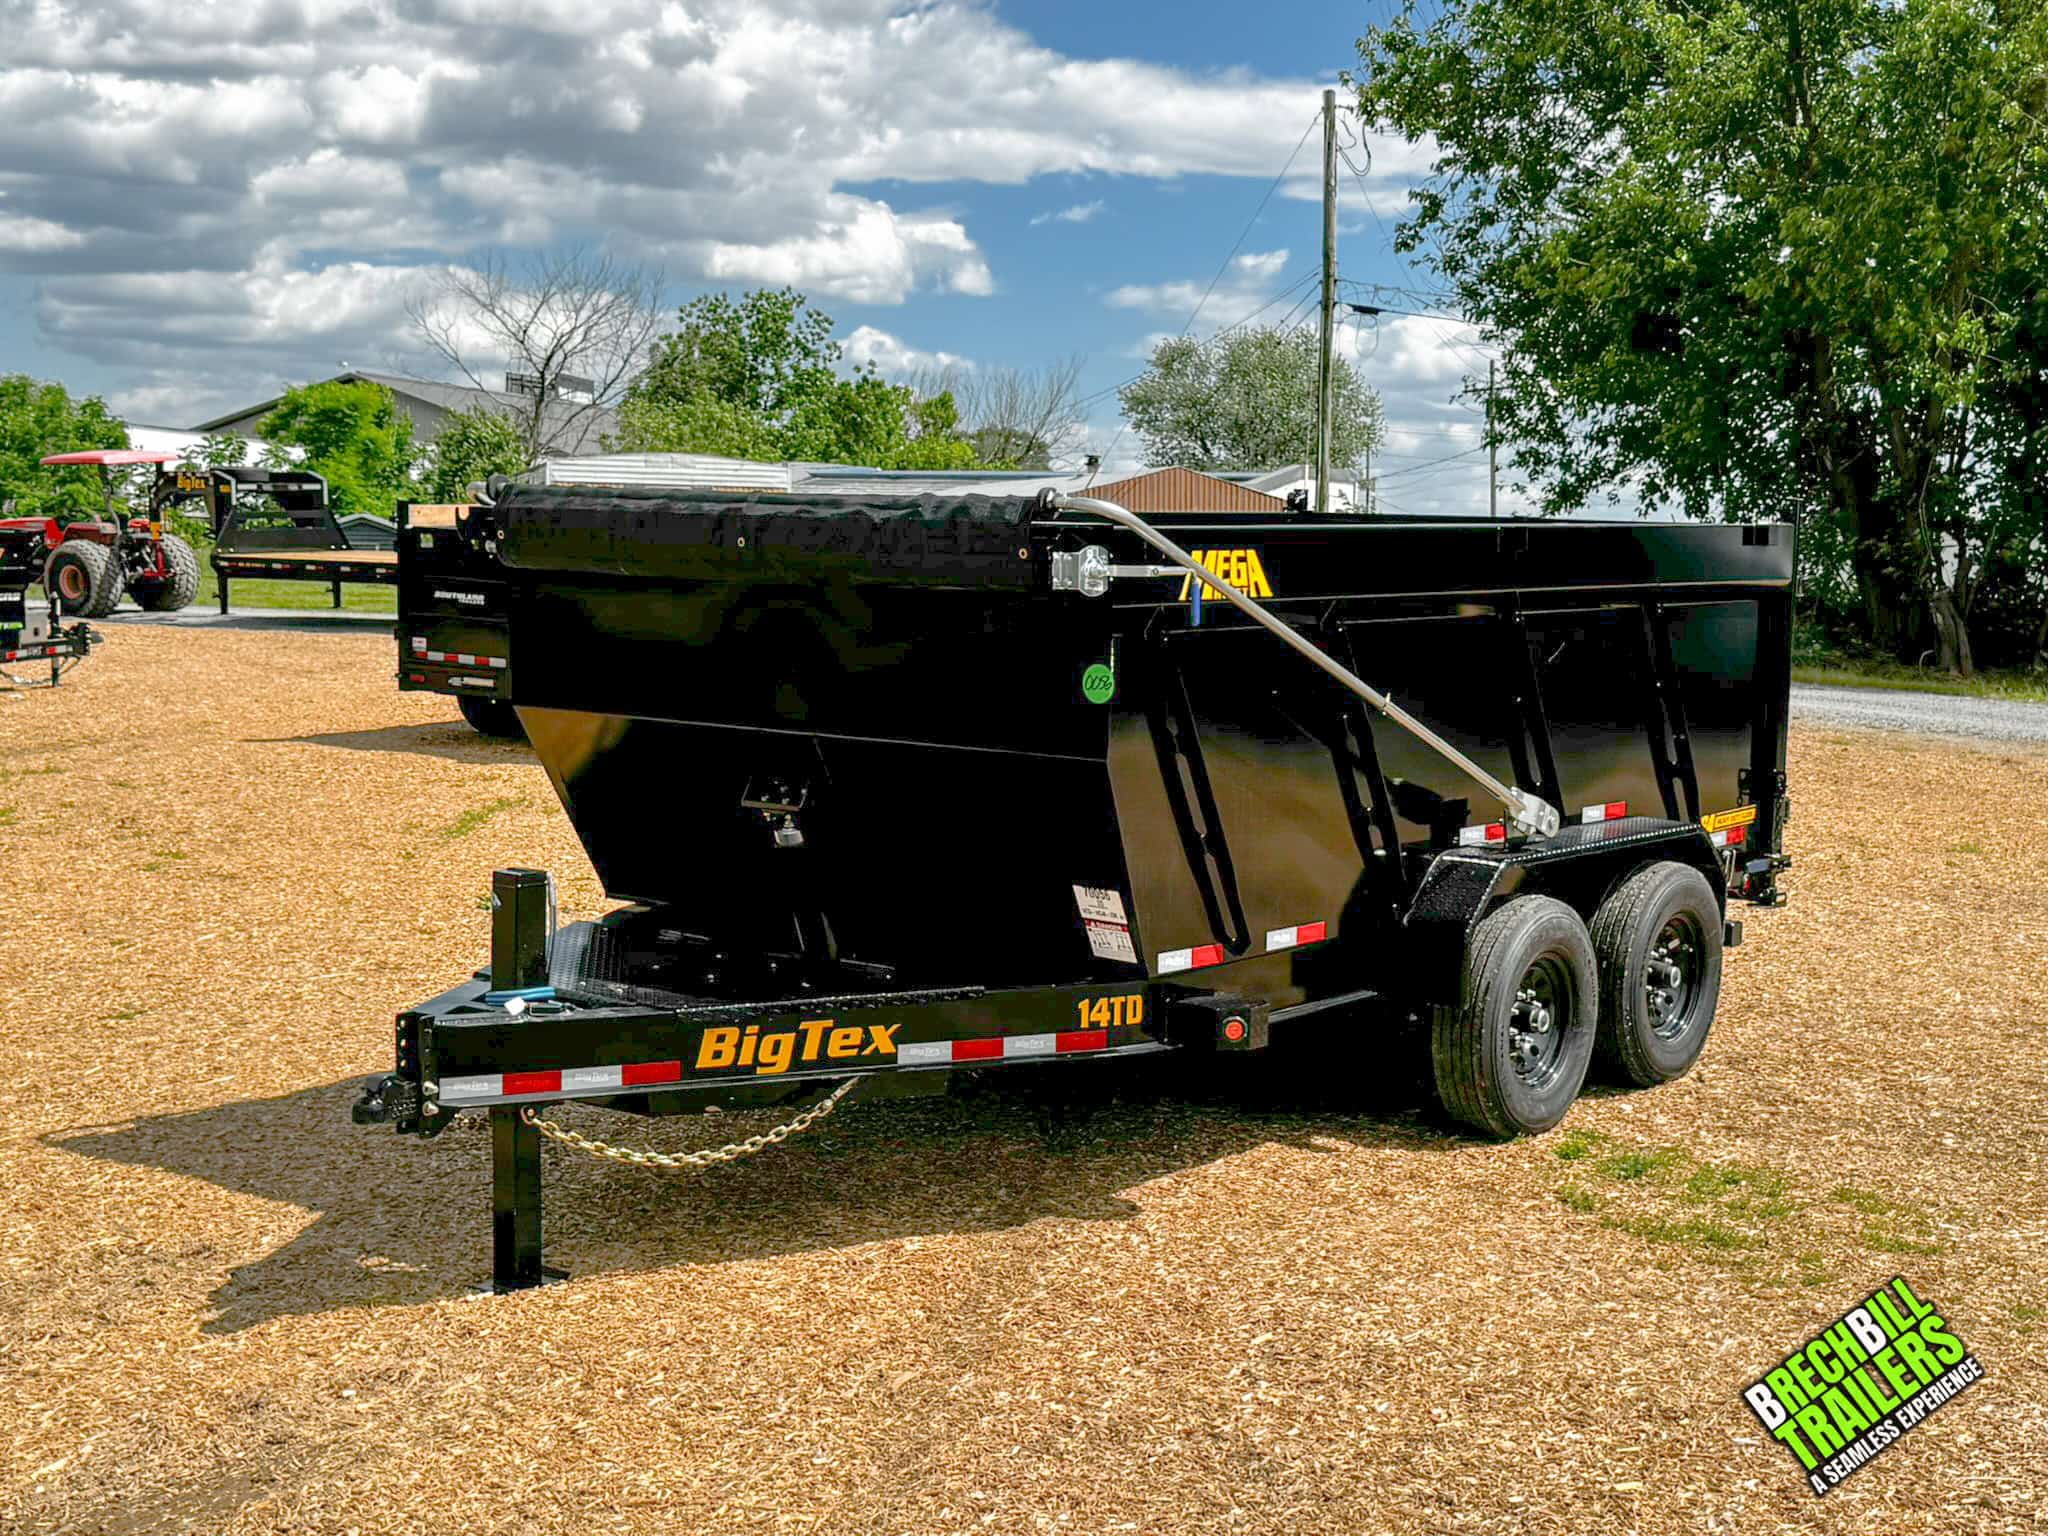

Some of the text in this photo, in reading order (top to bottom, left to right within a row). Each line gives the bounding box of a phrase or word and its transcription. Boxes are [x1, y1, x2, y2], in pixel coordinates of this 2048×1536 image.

[177, 474, 206, 491] BigTex
[1178, 550, 1273, 600] MEGA
[1078, 994, 1143, 1028] 14TD
[695, 1019, 902, 1075] BigTex
